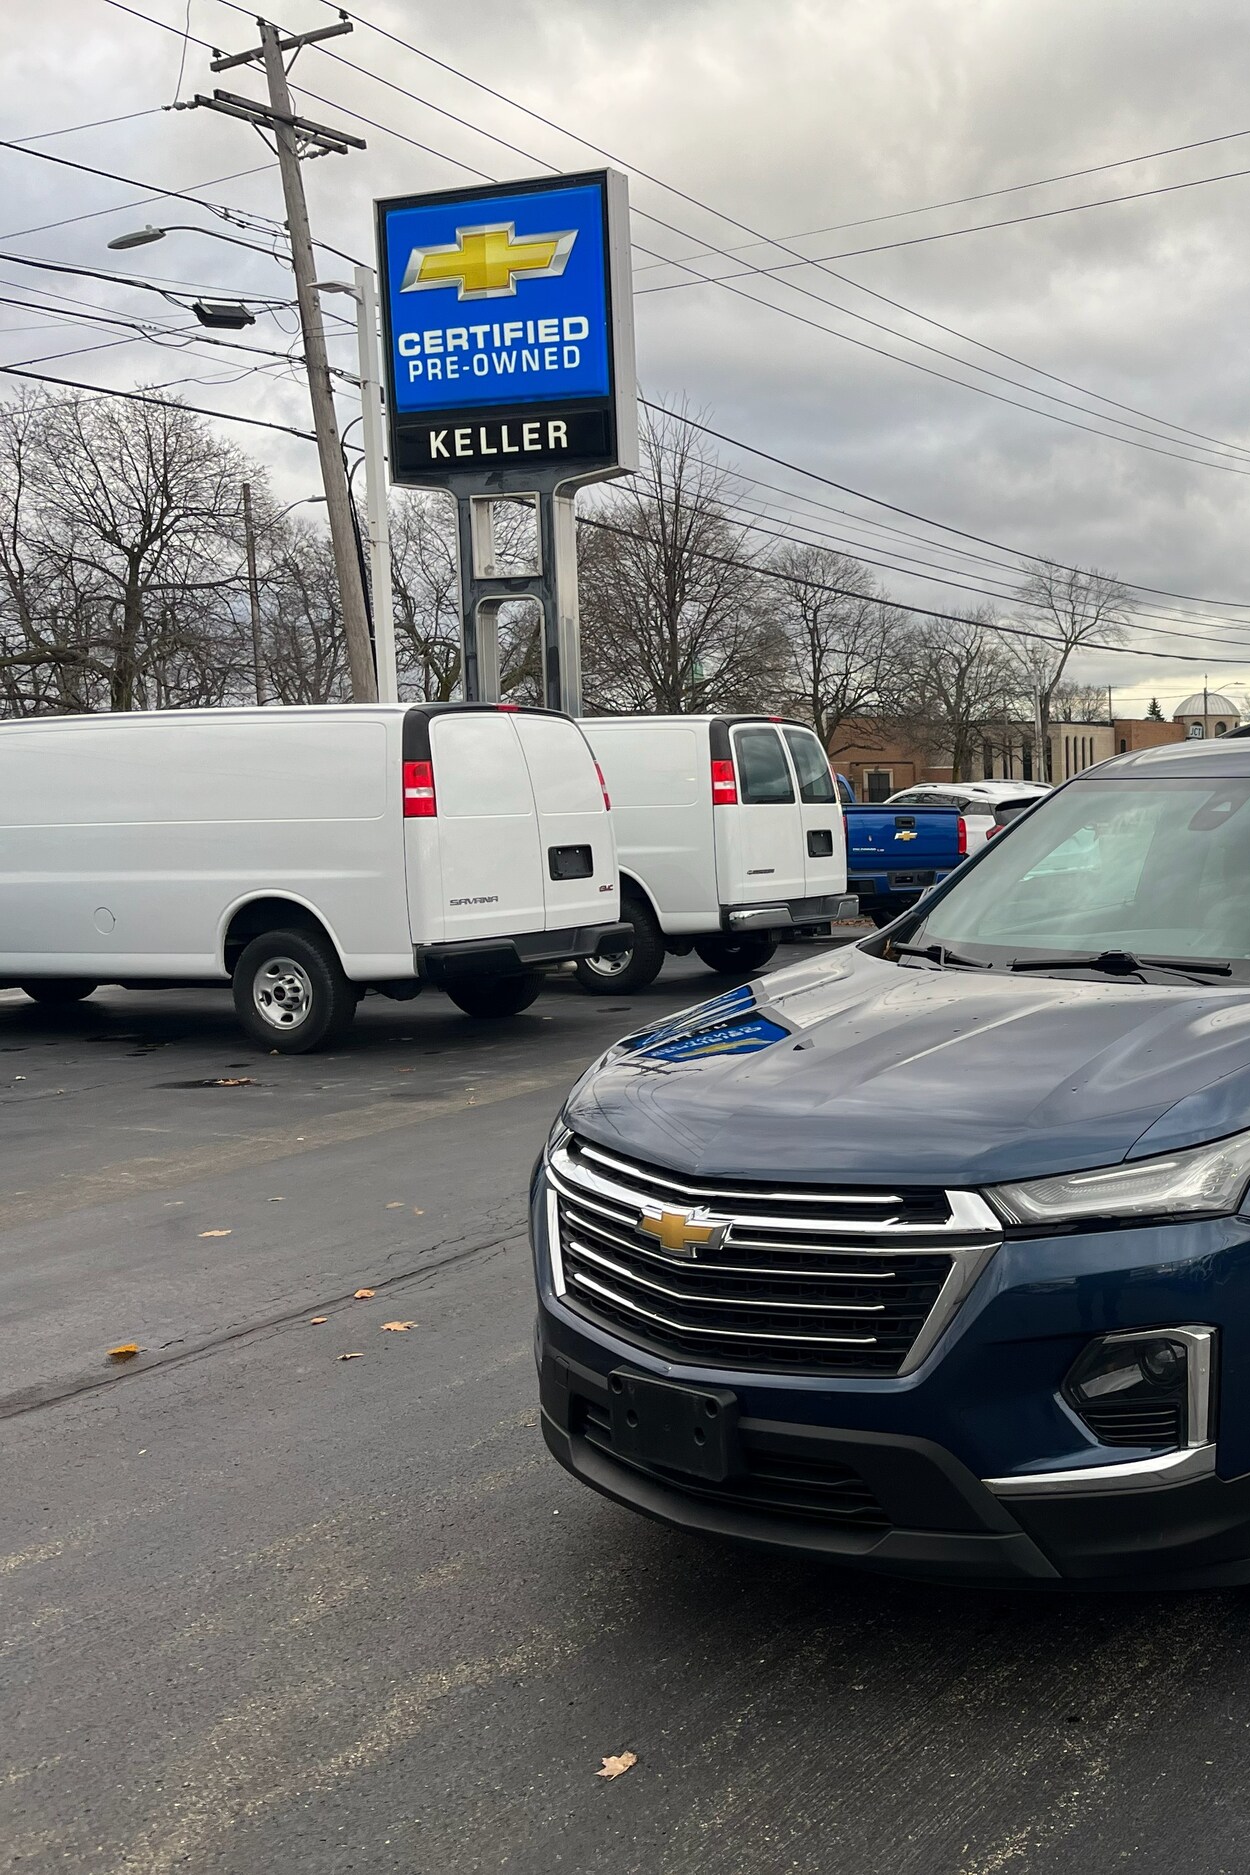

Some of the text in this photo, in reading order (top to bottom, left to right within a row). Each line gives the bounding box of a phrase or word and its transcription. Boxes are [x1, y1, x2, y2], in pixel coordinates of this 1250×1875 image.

[398, 316, 589, 357] CERTIFIED
[408, 345, 581, 383] PRE-OWNED
[429, 420, 568, 459] KELLER
[450, 895, 499, 906] SAVANA
